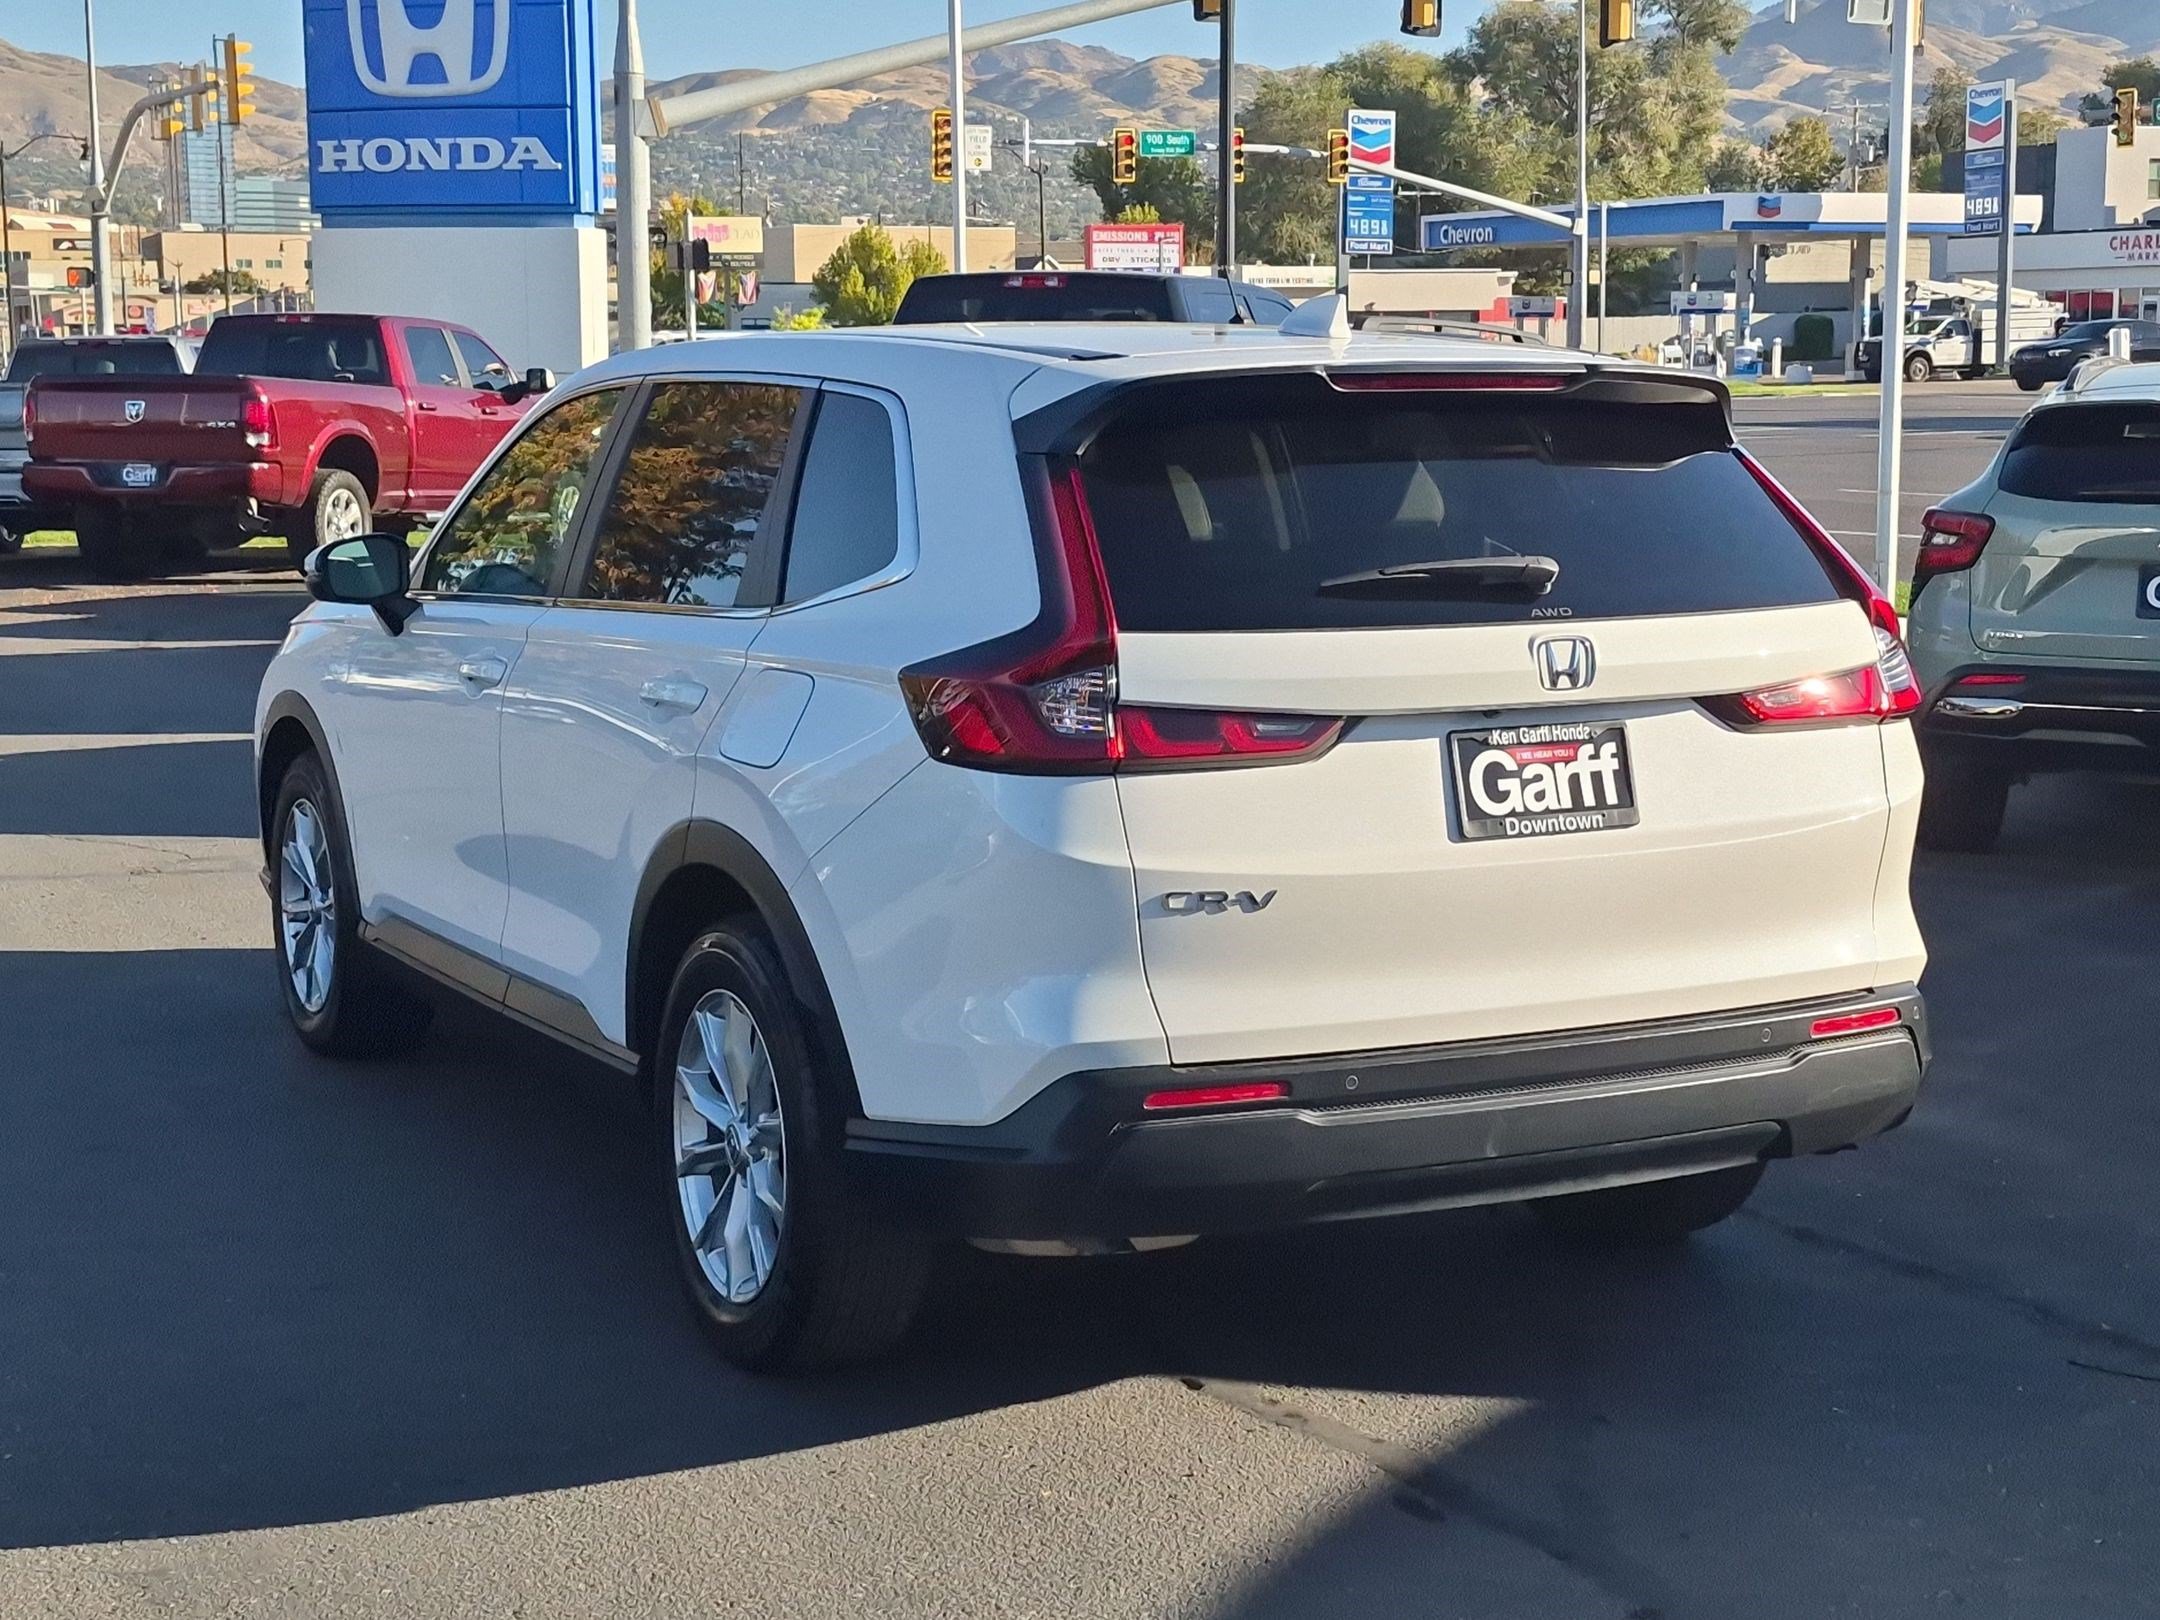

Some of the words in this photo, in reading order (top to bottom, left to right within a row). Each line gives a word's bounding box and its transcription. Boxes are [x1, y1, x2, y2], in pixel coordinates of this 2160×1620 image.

[1969, 87, 2002, 99] Chevron
[1350, 114, 1391, 126] Chevron
[1146, 134, 1163, 145] 900
[1166, 134, 1190, 145] South
[317, 136, 562, 173] HONDA
[1092, 230, 1149, 242] EMISSIONS
[1440, 224, 1494, 245] Chevron
[122, 467, 157, 482] Garff
[1530, 607, 1573, 617] AWD
[1491, 729, 1517, 745] Ken
[1518, 727, 1550, 744] Garff
[1553, 748, 1570, 758] YOU
[1469, 742, 1619, 816] Garff
[1504, 813, 1604, 836] Downtown
[1161, 889, 1278, 916] CR-V
